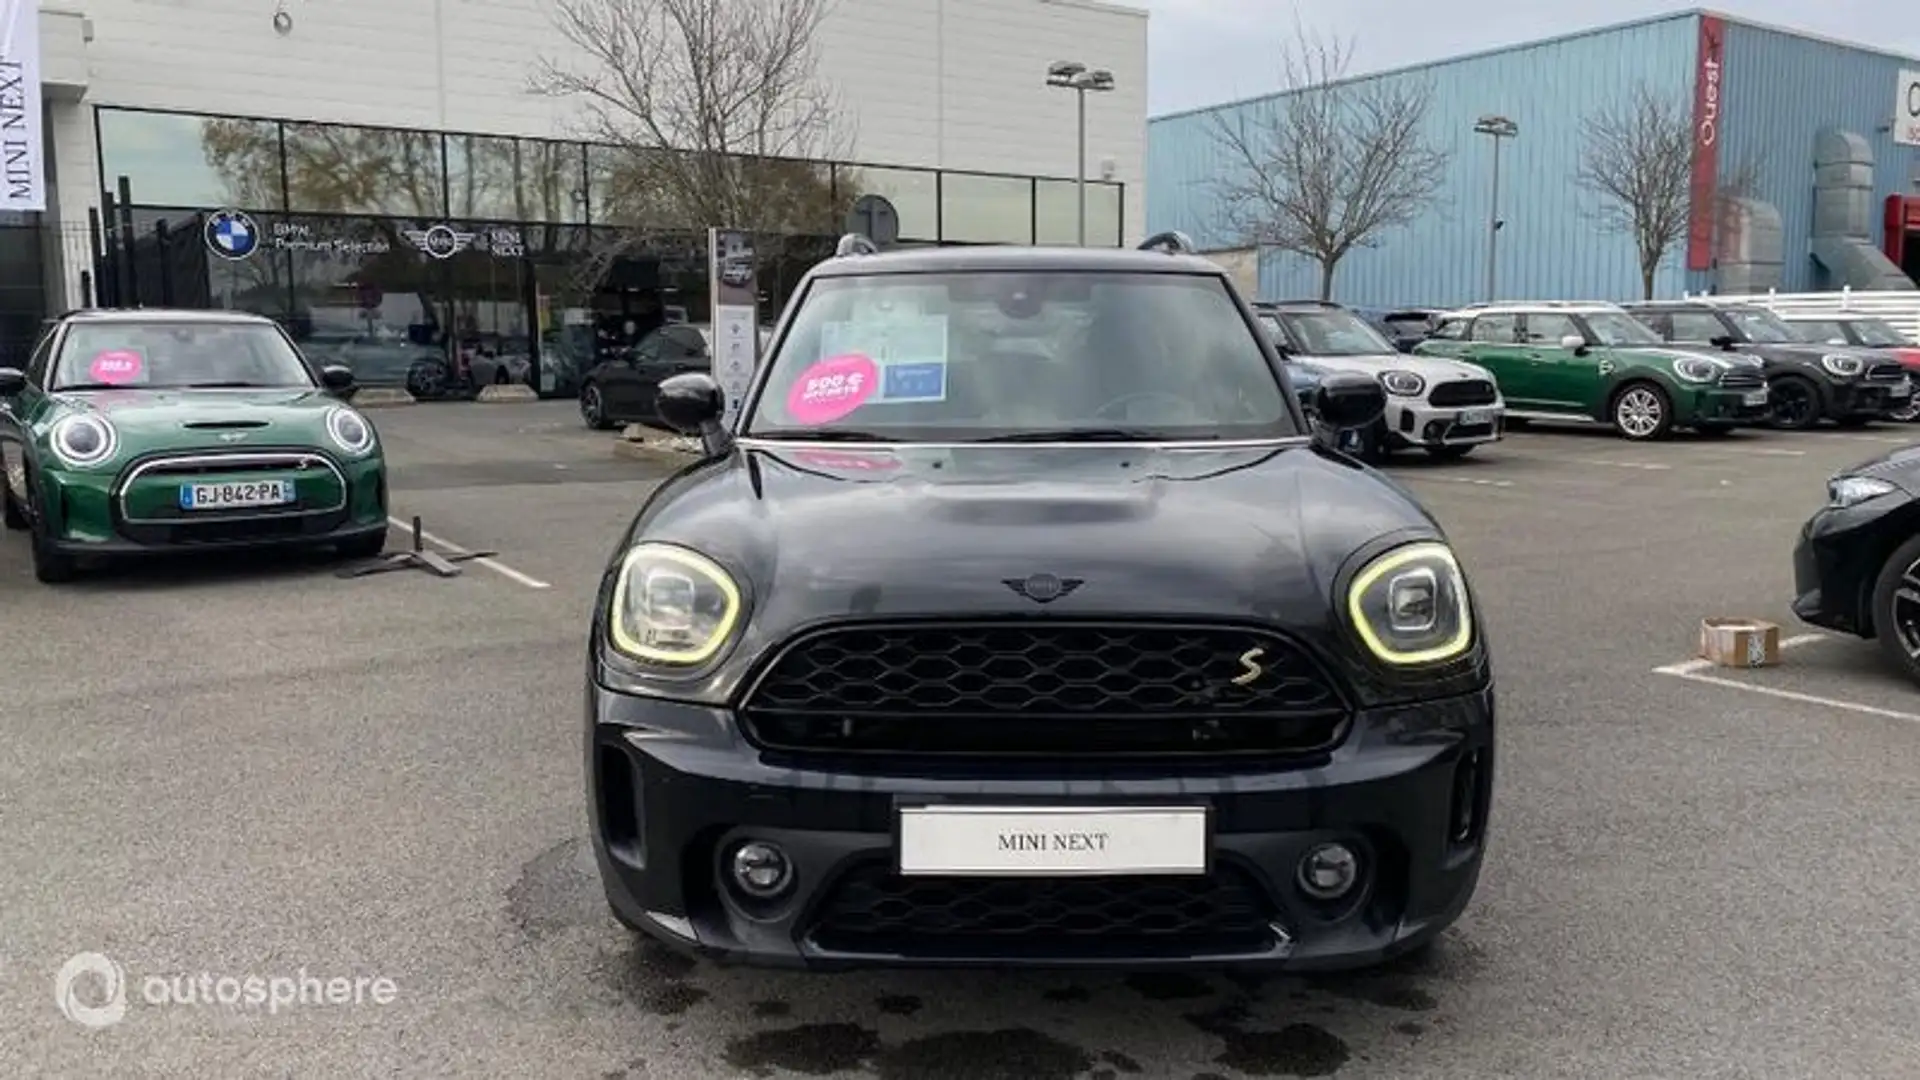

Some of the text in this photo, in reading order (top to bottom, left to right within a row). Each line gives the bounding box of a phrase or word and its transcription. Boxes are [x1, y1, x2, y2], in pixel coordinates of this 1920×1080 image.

[1701, 58, 1719, 145] Ouest
[4, 140, 31, 200] MINI
[1231, 648, 1264, 685] S
[998, 833, 1109, 850] MINI NEXT
